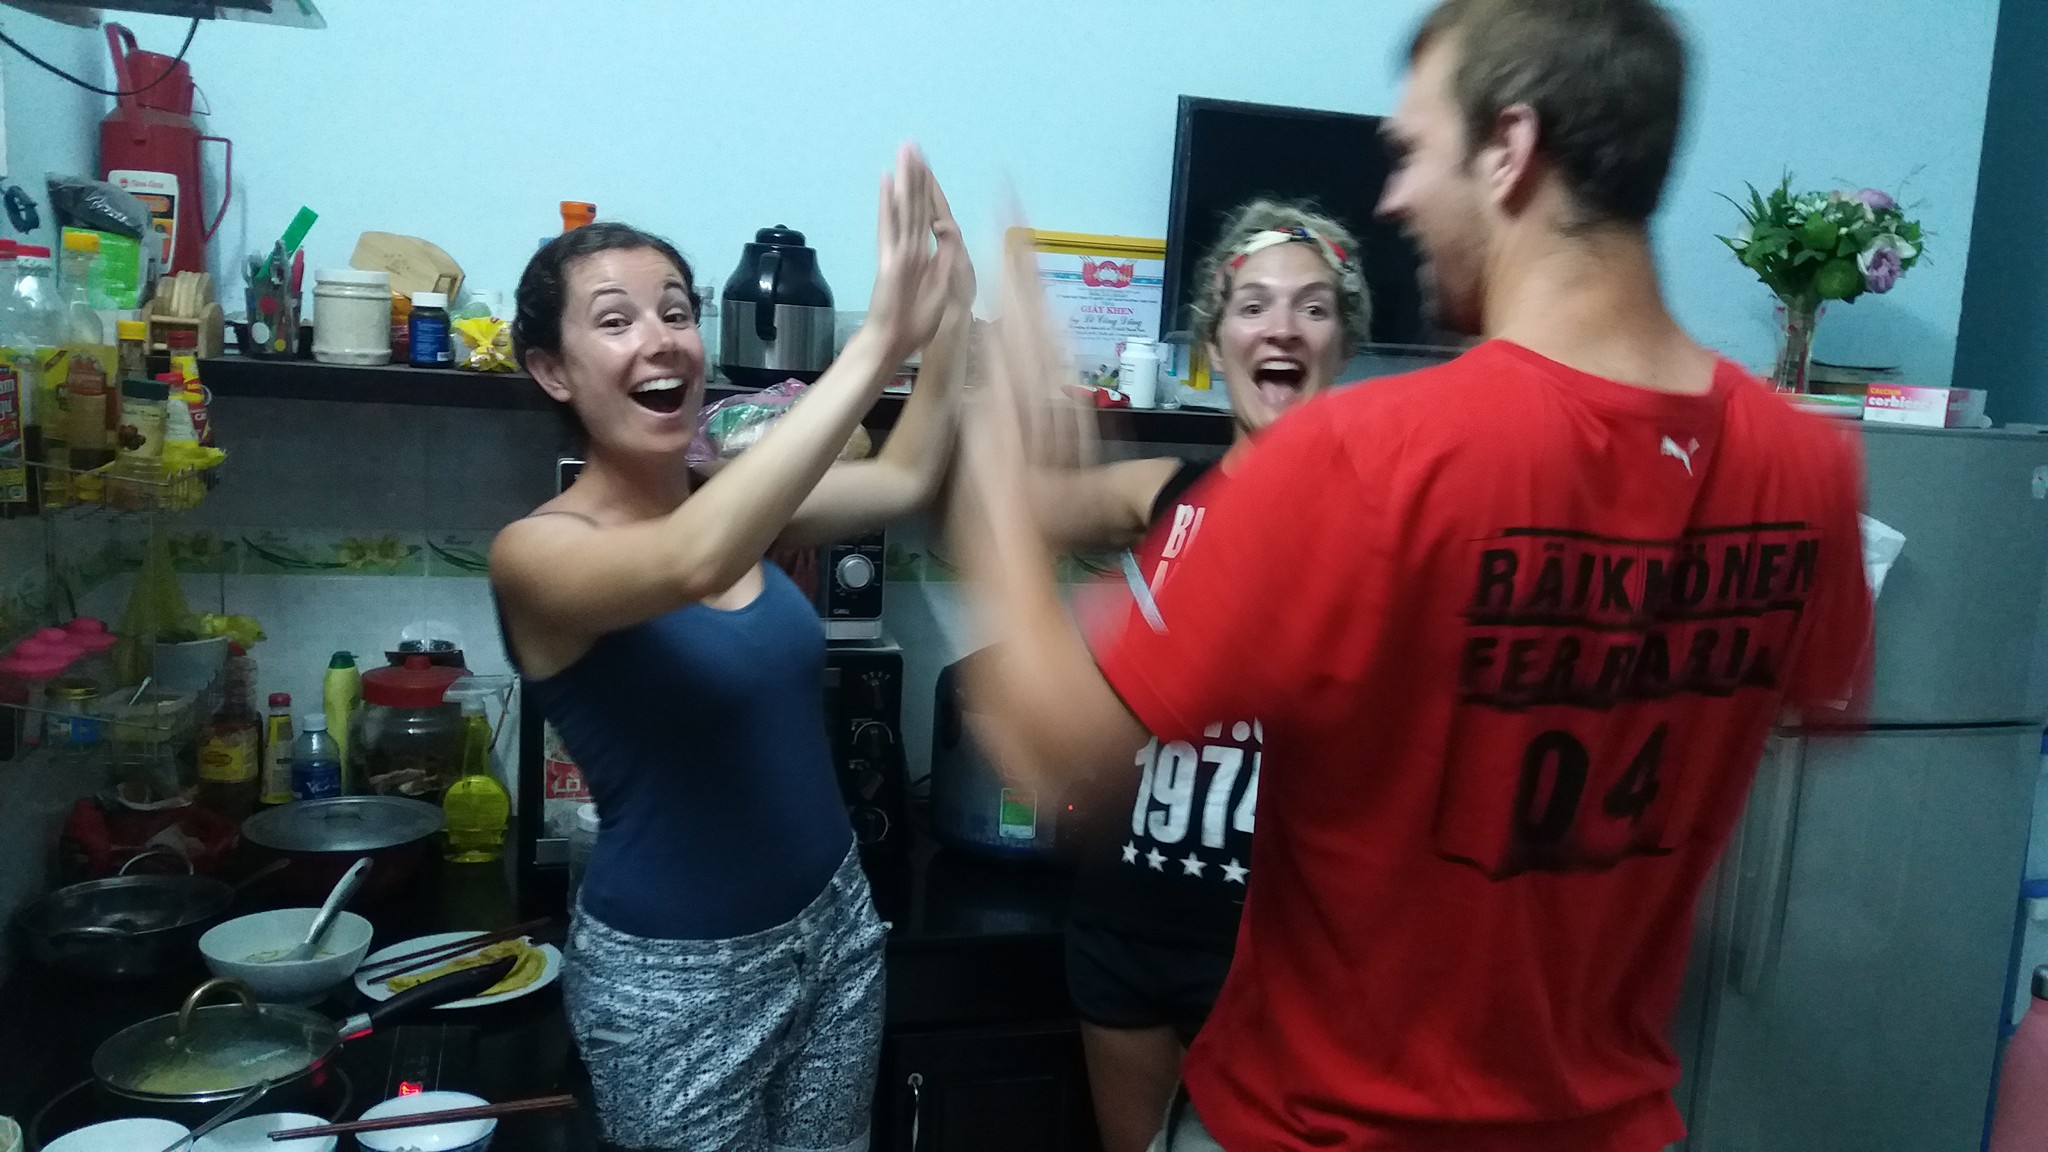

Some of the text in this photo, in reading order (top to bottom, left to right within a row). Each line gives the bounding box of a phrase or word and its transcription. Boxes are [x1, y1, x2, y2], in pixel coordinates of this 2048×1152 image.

[1106, 307, 1134, 316] KHEN
[1458, 626, 1751, 694] FERRARI
[1512, 722, 1668, 850] 04
